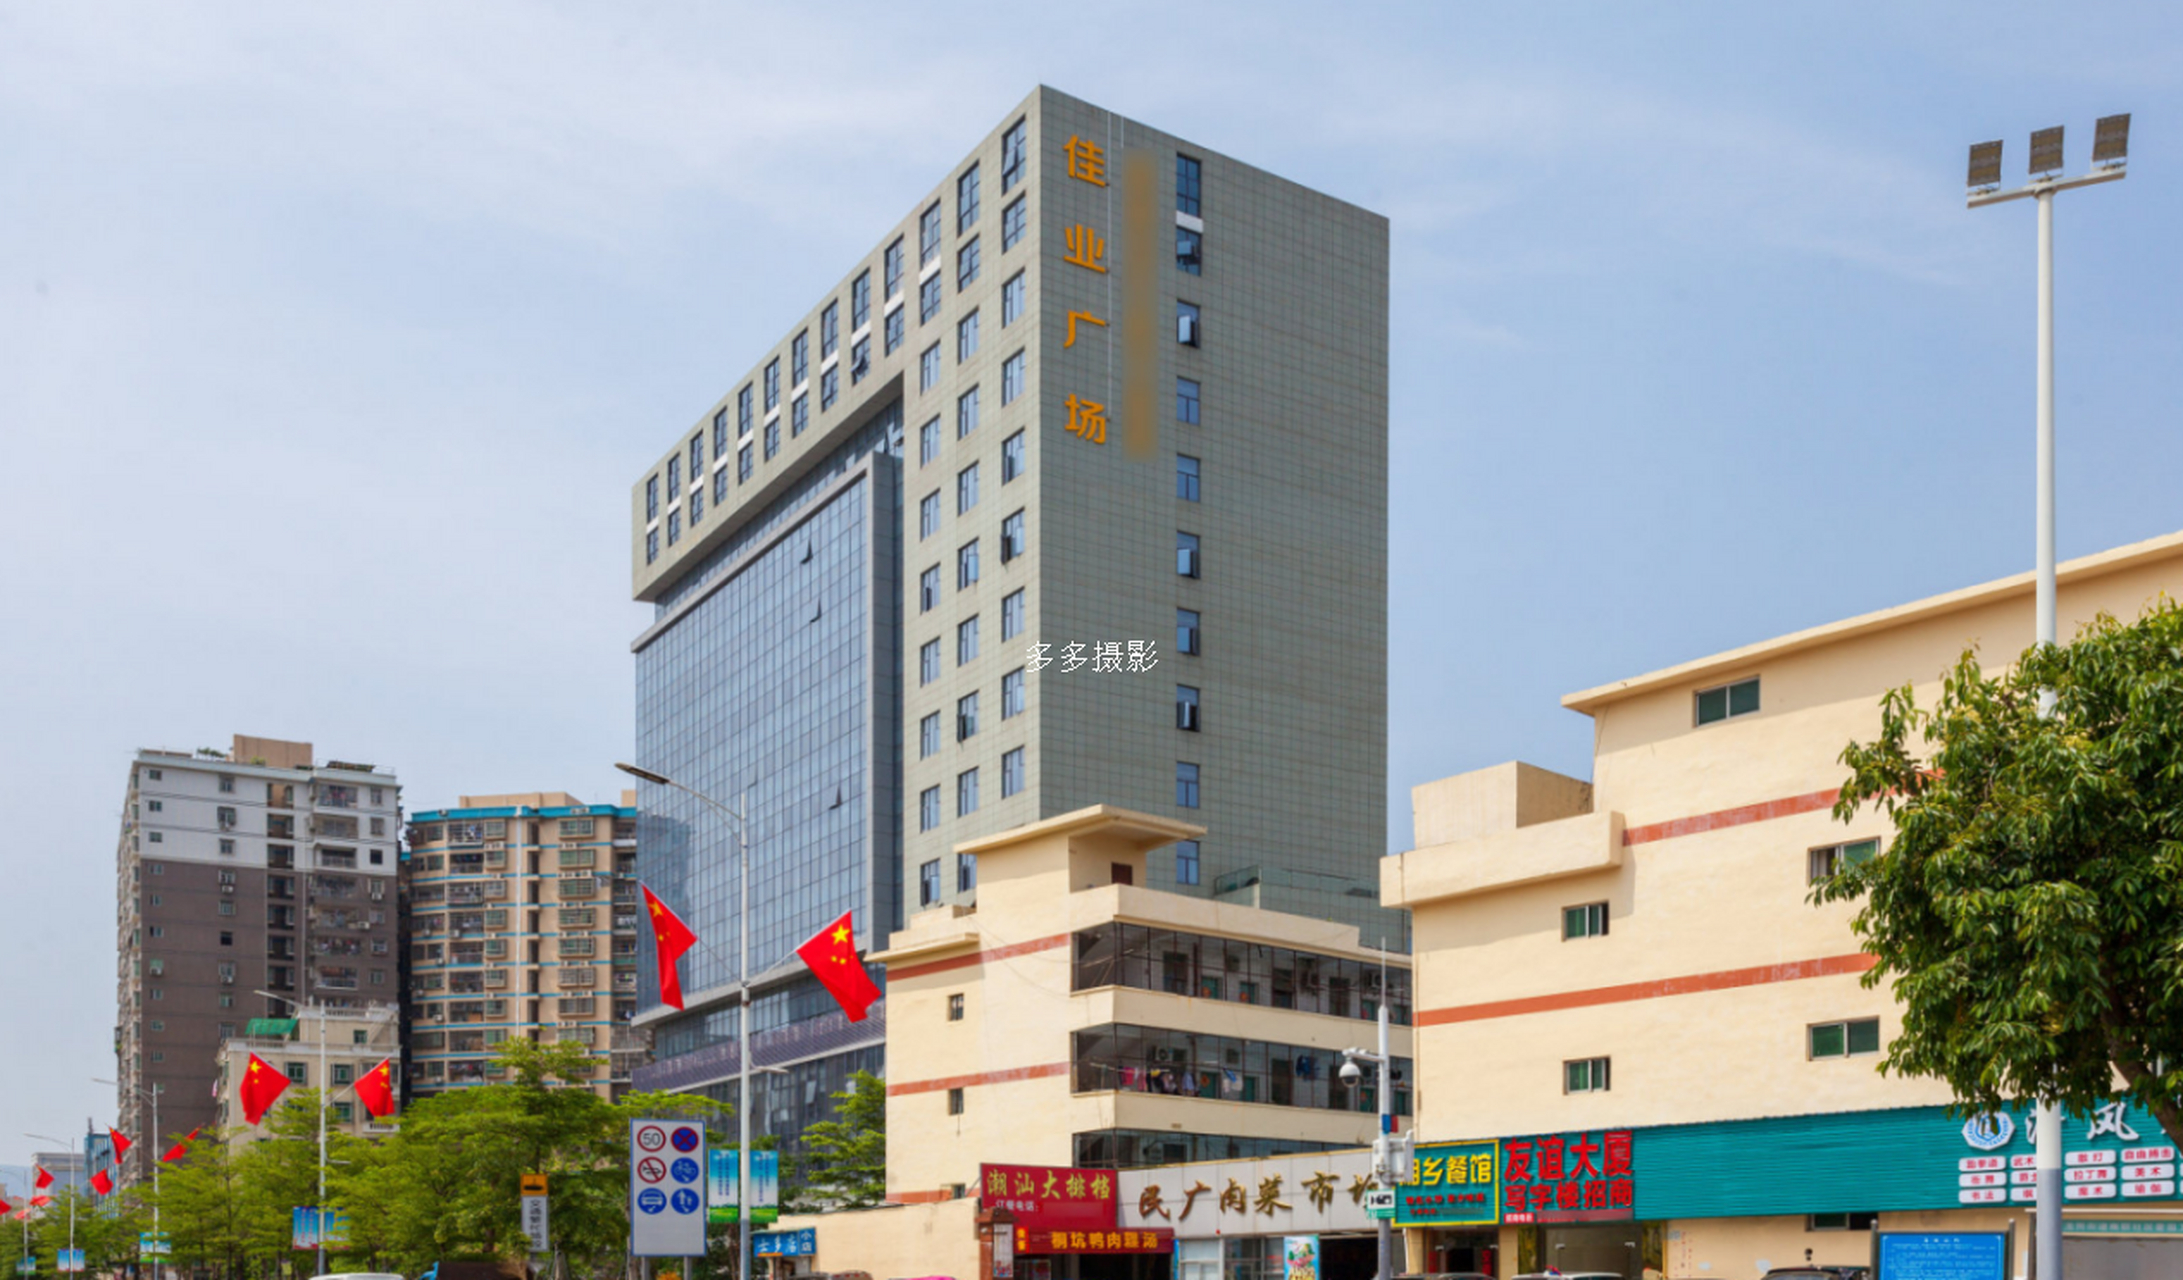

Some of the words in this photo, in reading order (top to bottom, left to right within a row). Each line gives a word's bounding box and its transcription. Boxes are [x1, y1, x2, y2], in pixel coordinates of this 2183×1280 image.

[1063, 134, 1108, 444] 佳业广场
[642, 1132, 661, 1145] 50
[1503, 1130, 1633, 1182] 友谊大厦
[986, 1168, 1111, 1200] 潮汕大排档
[2074, 1169, 2107, 1180] 拉丁舞
[1504, 1178, 1633, 1211] 写字楼招商
